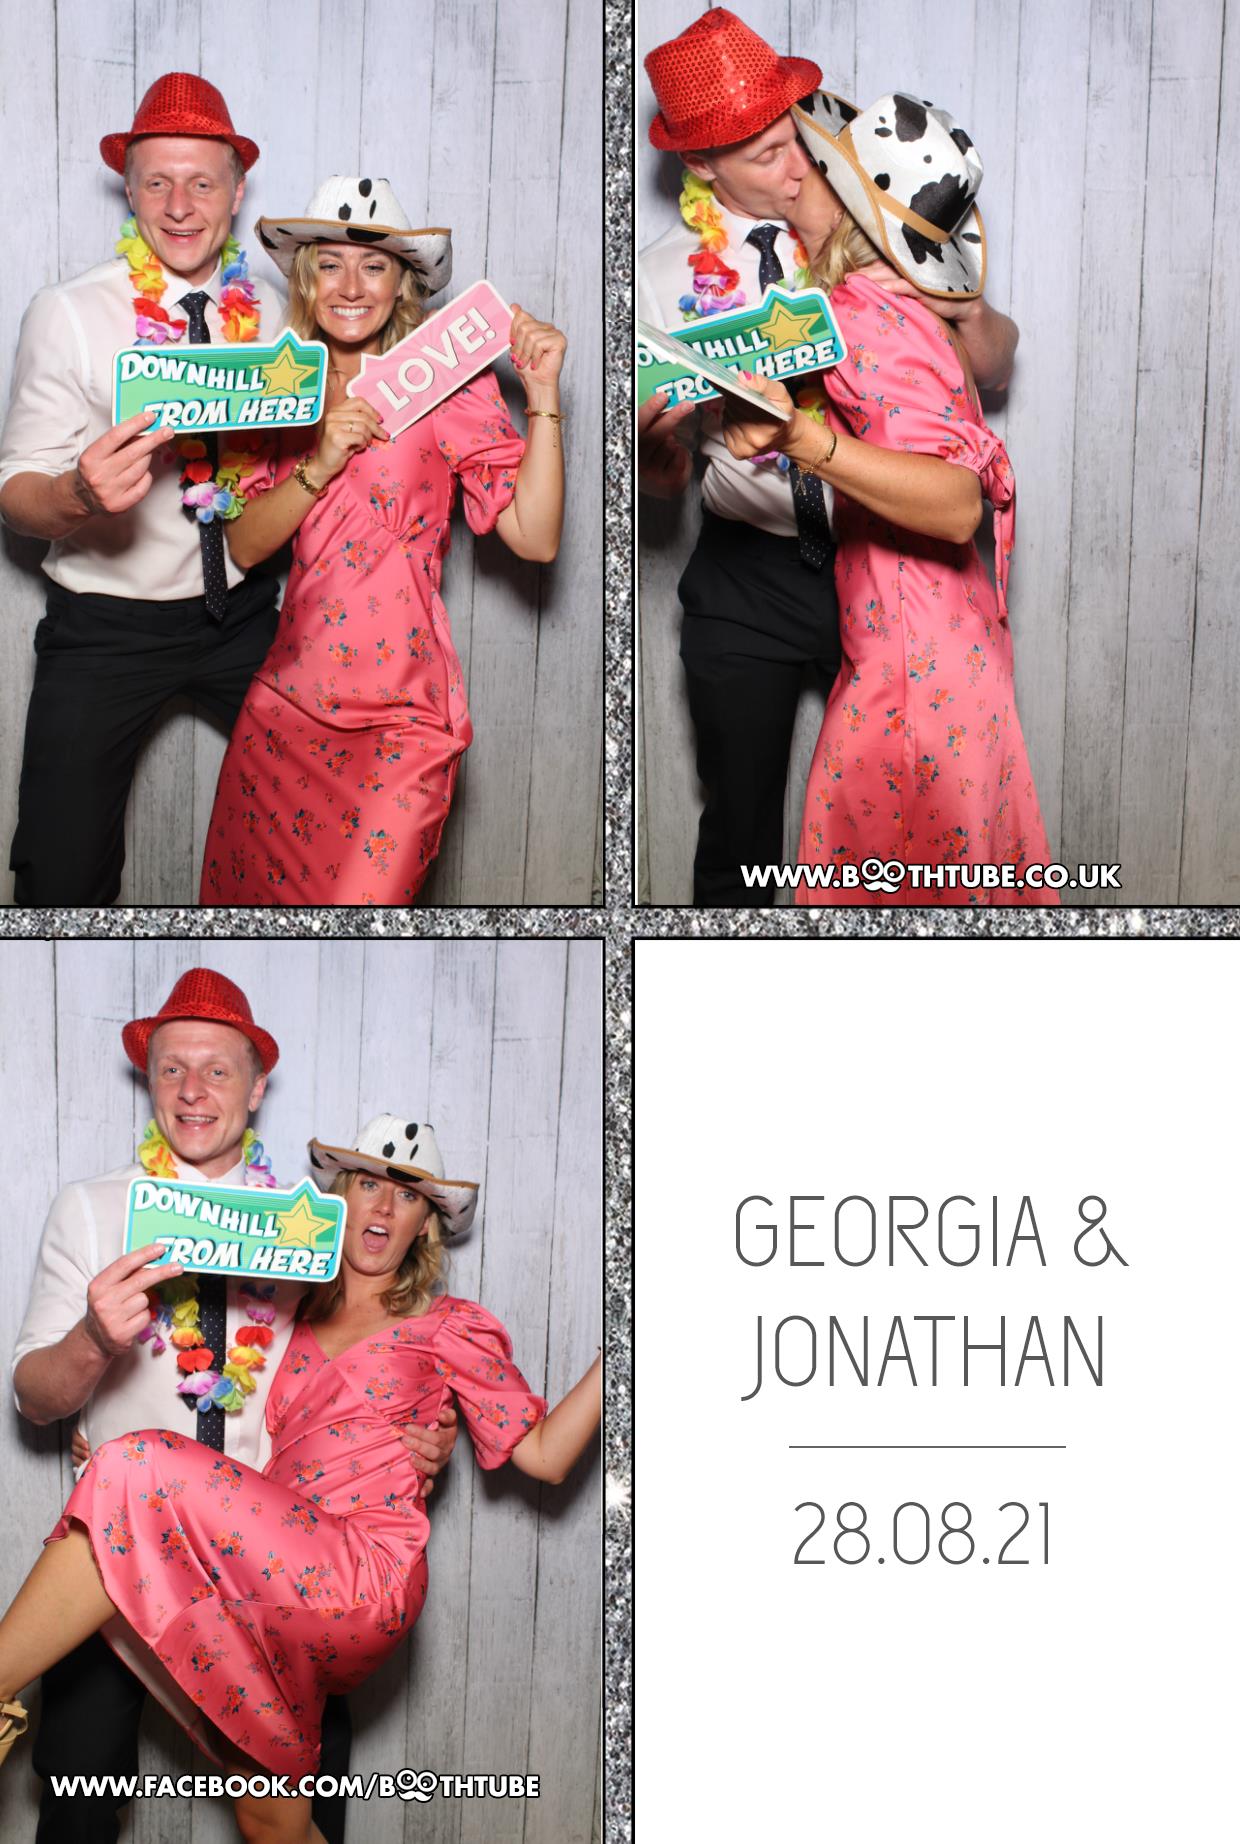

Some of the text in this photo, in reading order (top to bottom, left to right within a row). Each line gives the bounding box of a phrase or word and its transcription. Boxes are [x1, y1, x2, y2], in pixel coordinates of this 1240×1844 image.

[376, 307, 497, 412] LOVE!
[638, 329, 770, 367] OHILL
[120, 352, 265, 392] DOWNHILL
[655, 338, 836, 401] FRO HERE
[237, 395, 318, 423] HERE
[133, 1182, 281, 1239] DOWNHILL
[249, 1246, 334, 1277] HERE
